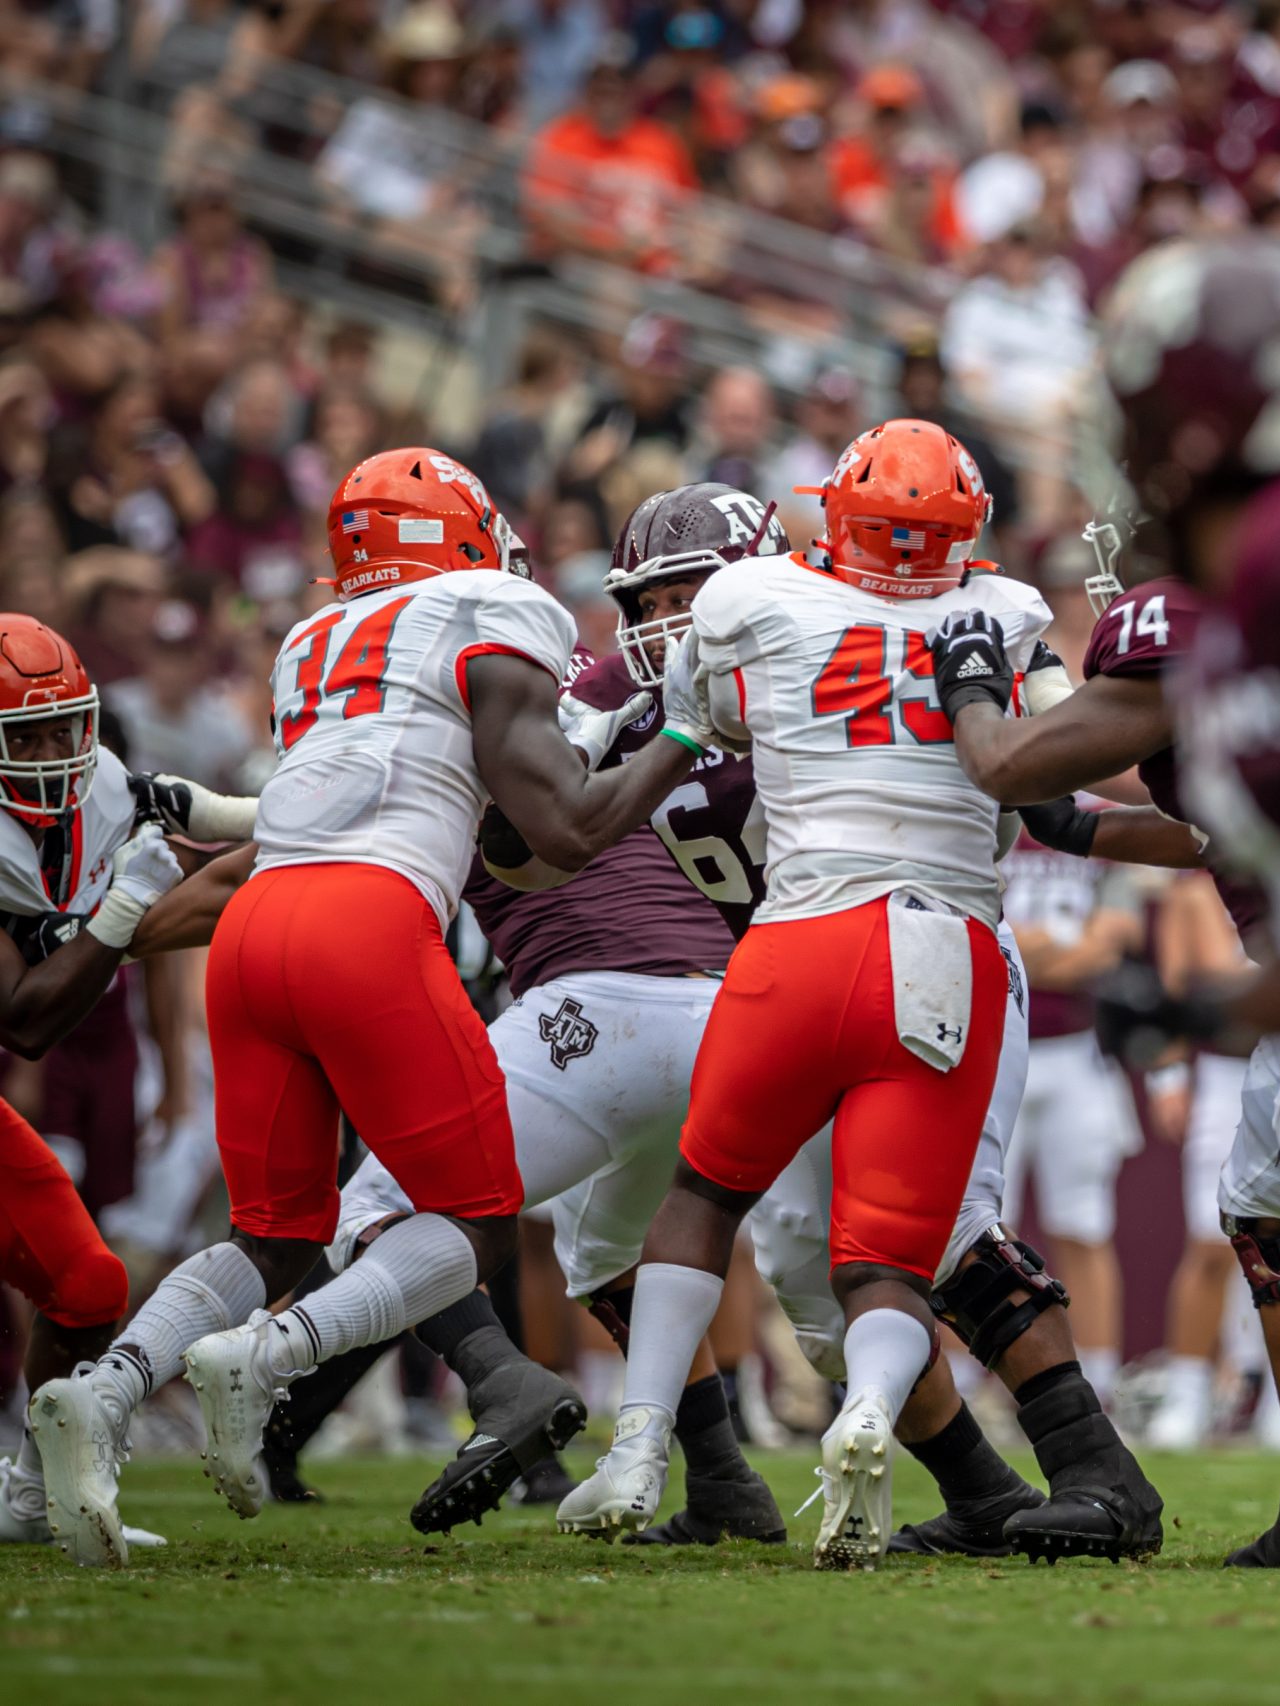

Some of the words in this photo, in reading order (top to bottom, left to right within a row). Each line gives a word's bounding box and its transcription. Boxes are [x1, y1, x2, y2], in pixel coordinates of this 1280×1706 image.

[352, 548, 368, 563] 34
[340, 566, 401, 595] BEARKATS
[894, 563, 912, 575] 45
[860, 576, 934, 595] BEARKATS
[1108, 594, 1170, 656] 74
[282, 594, 418, 752] 34
[956, 666, 994, 679] adidas
[650, 781, 770, 904] 6
